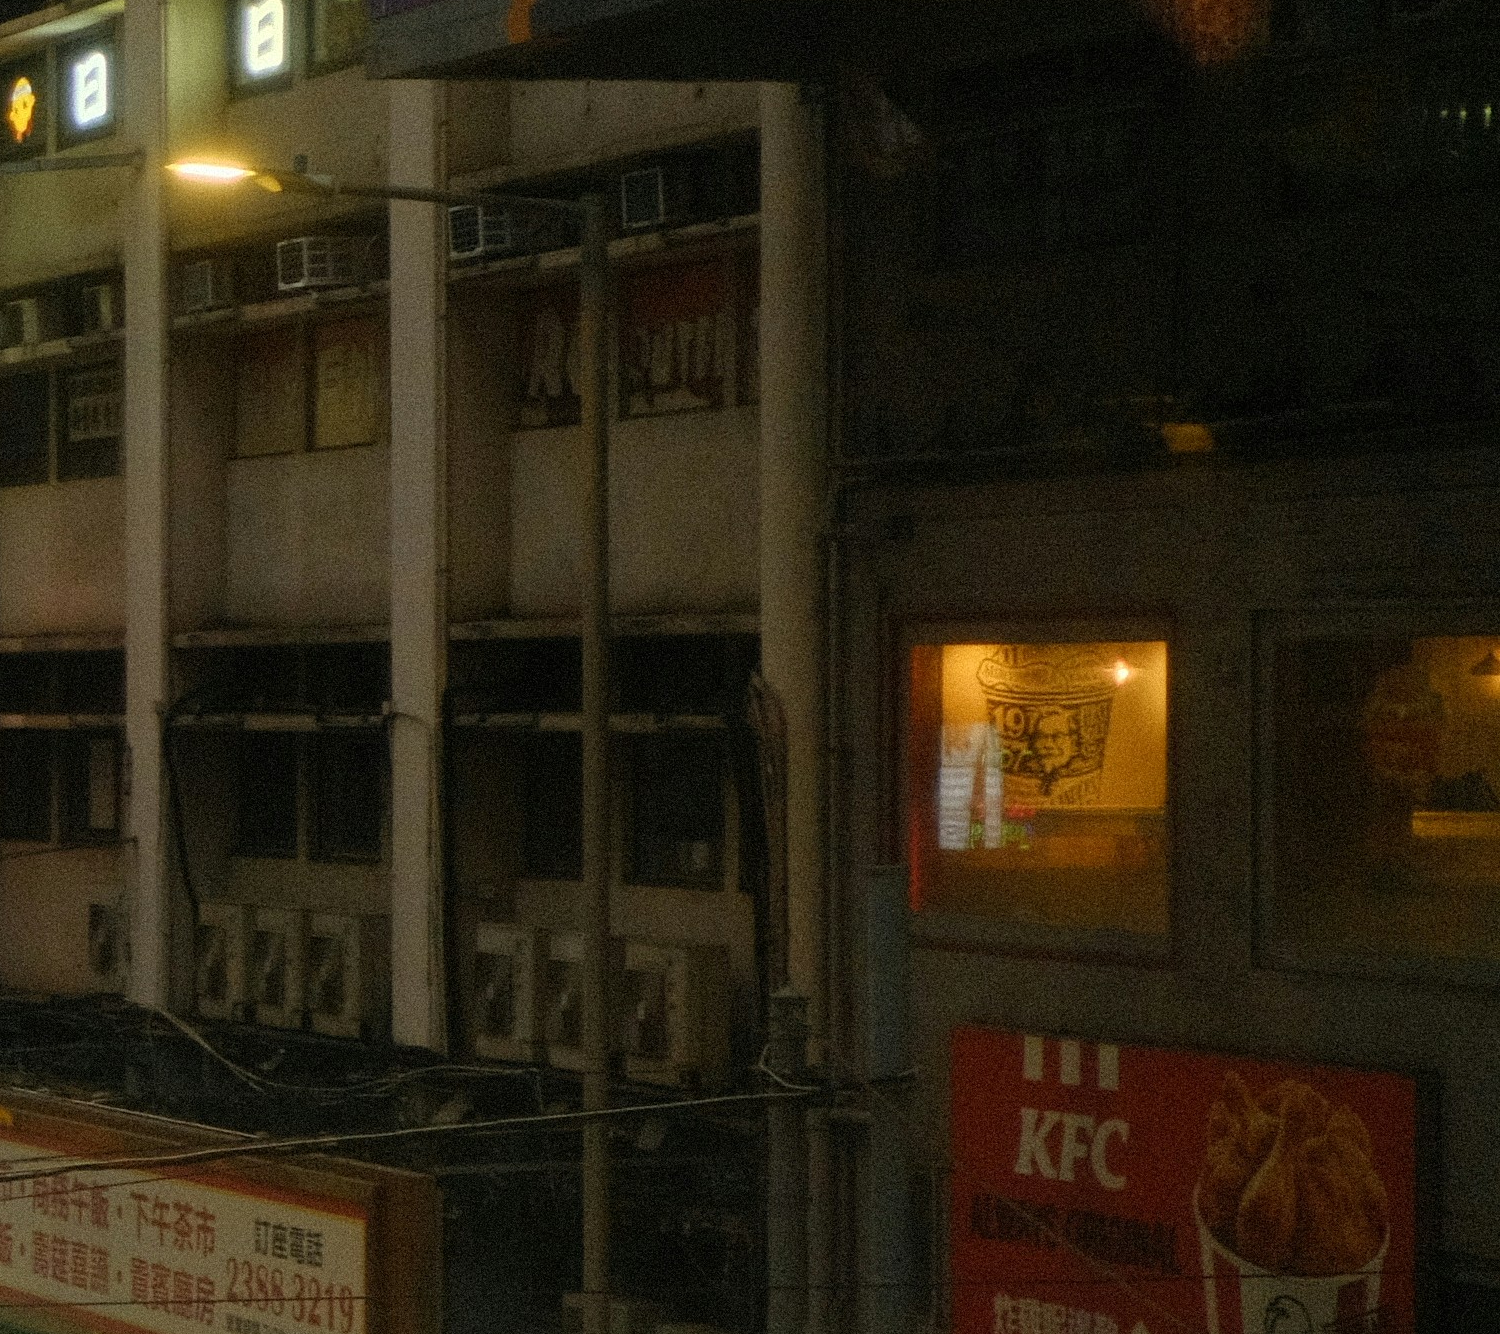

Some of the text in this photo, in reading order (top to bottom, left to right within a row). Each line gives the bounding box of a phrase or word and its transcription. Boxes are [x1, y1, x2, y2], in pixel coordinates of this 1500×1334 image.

[1014, 1107, 1130, 1192] KFC
[130, 1191, 216, 1257] 下午茶市
[292, 1272, 354, 1334] 3219
